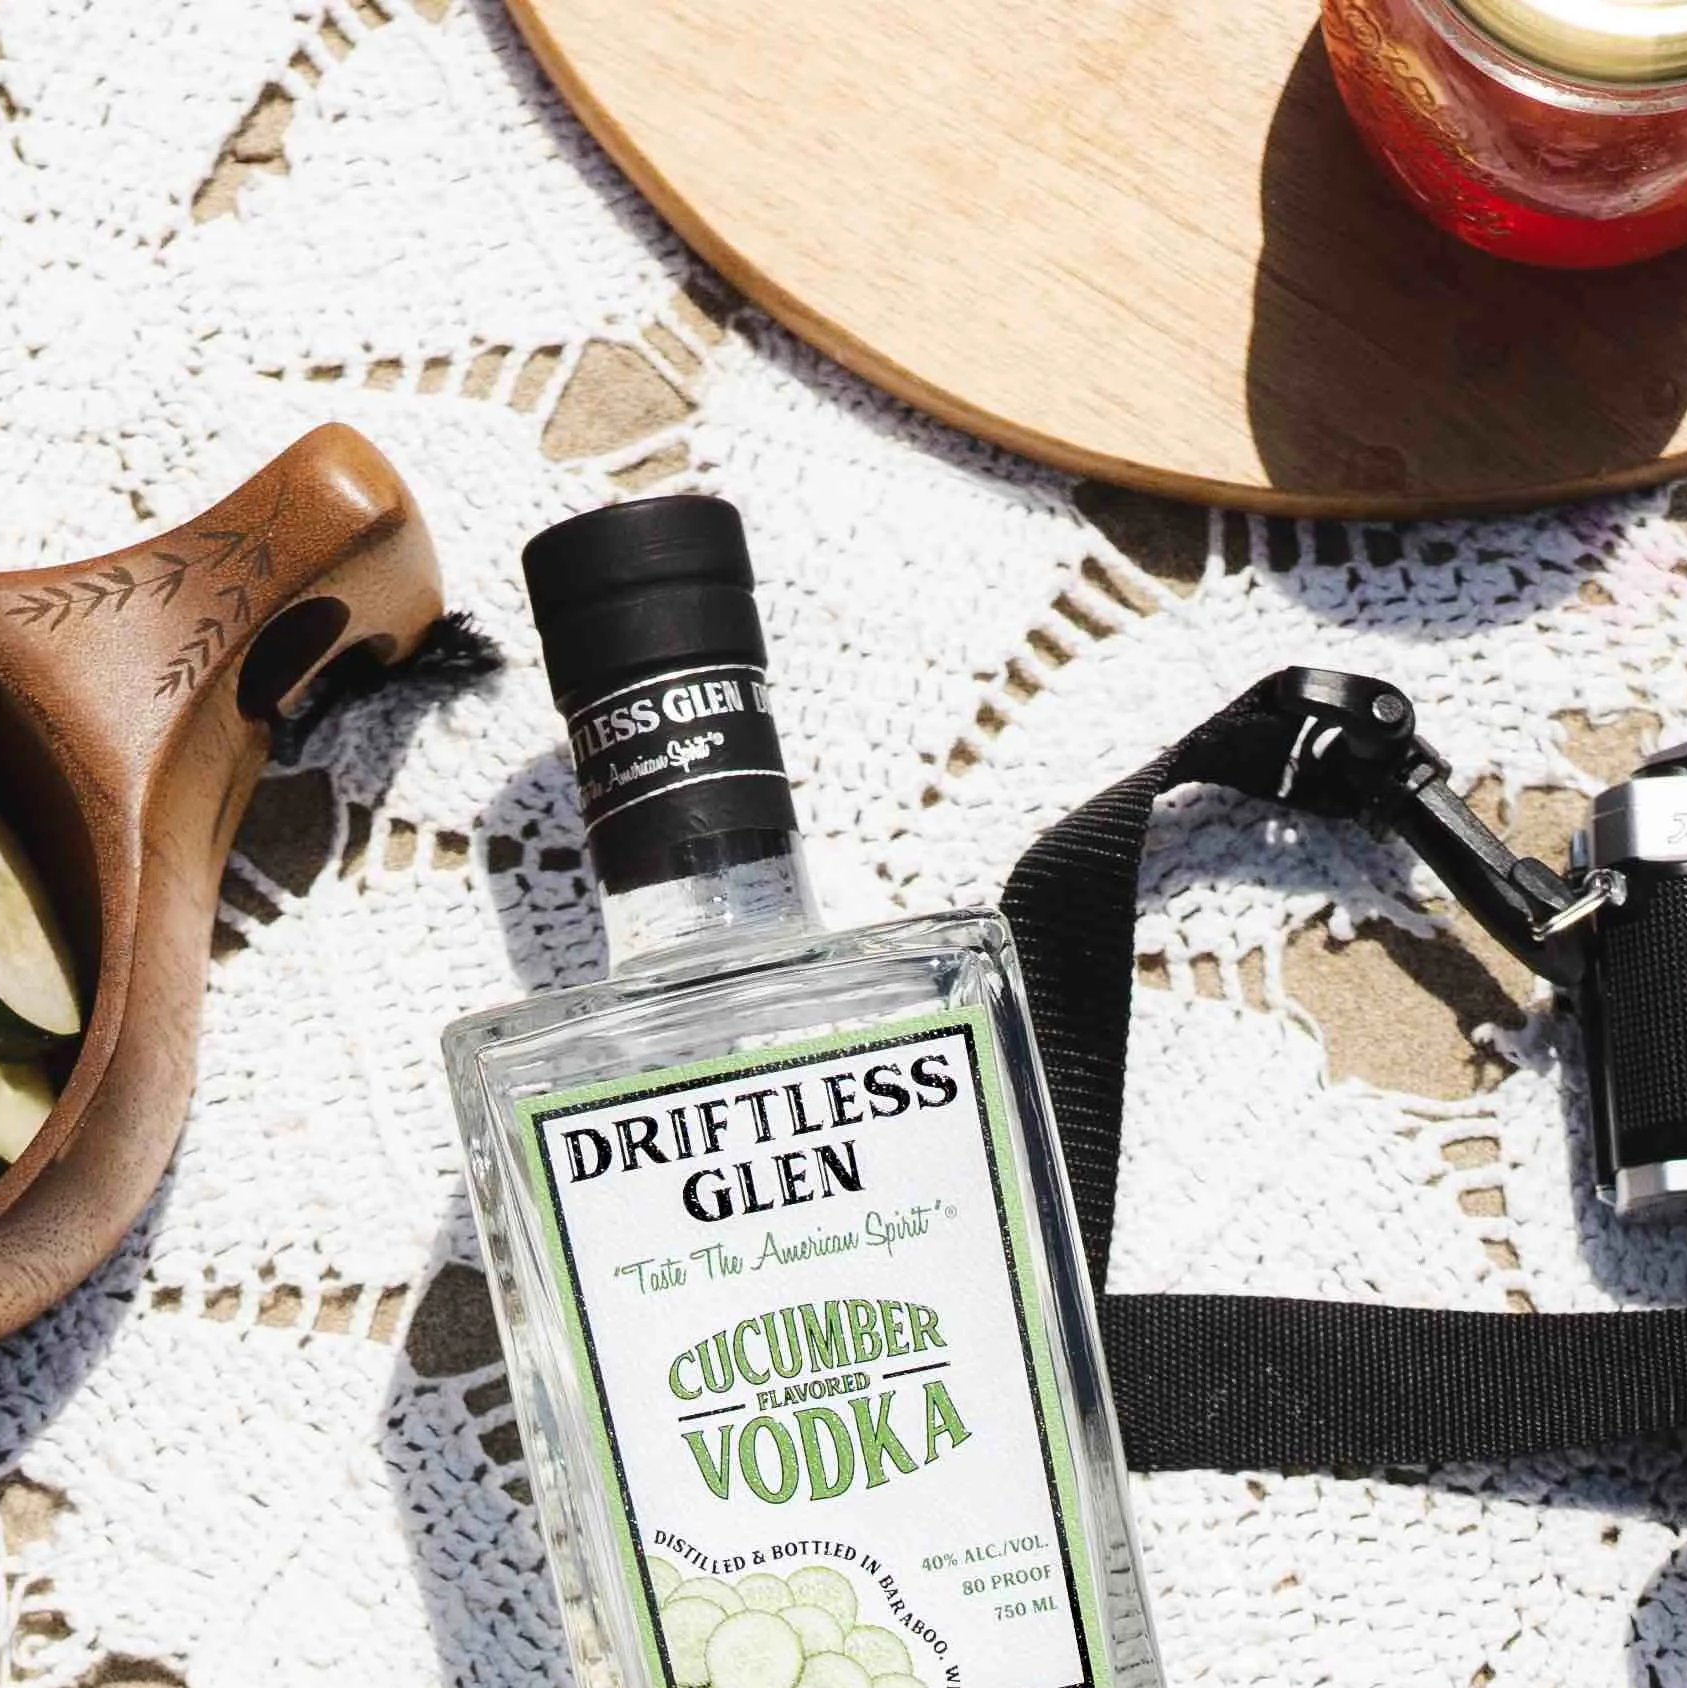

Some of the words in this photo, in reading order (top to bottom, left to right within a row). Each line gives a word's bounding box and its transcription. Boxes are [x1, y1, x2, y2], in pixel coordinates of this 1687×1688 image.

[663, 680, 745, 723] GLEN
[605, 754, 668, 793] American
[561, 1054, 958, 1184] DRIFTLESS
[683, 1139, 867, 1223] GLEN
[689, 1242, 744, 1281] The
[750, 1228, 859, 1271] American
[669, 1299, 948, 1400] CUCUMBER
[756, 1372, 871, 1411] FLAVORED
[681, 1380, 972, 1504] VODKA
[653, 1529, 746, 1574] DISTILLED
[752, 1550, 766, 1565] &
[771, 1540, 857, 1561] BOTTLED
[860, 1555, 882, 1575] IN
[921, 1553, 958, 1572] 40%
[962, 1579, 985, 1596] 80
[992, 1565, 1052, 1590] PROOF
[994, 1601, 1027, 1621] 750
[1032, 1596, 1058, 1614] ML
